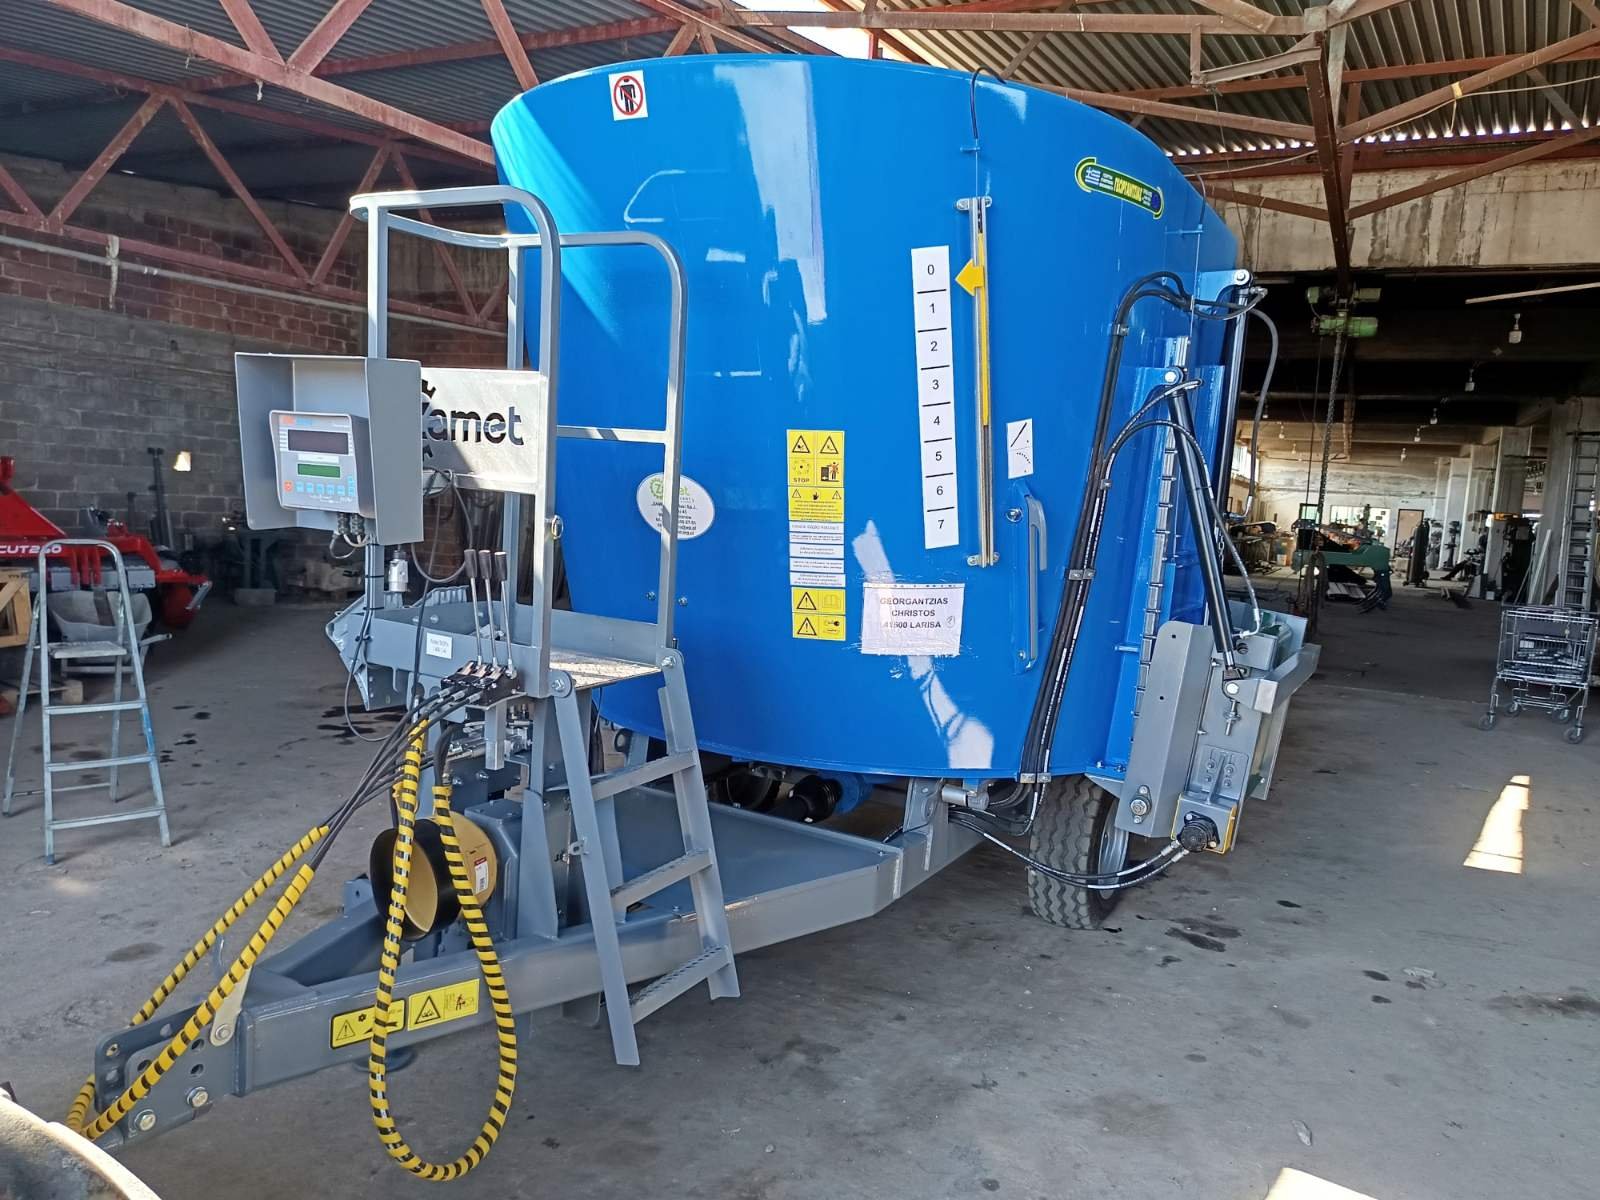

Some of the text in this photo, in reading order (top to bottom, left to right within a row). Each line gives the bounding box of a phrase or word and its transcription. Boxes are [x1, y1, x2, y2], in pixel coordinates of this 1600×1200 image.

[927, 264, 935, 275] 0
[929, 303, 936, 314] 1
[930, 340, 938, 352] 2
[932, 379, 940, 390] 3
[933, 415, 941, 426] 4
[935, 450, 943, 462] 5
[936, 485, 944, 496] 6
[937, 519, 945, 529] 7
[879, 597, 948, 605] GEORGANTZIAS
[891, 609, 936, 617] CHRISTOS
[909, 621, 942, 629] LARISA
